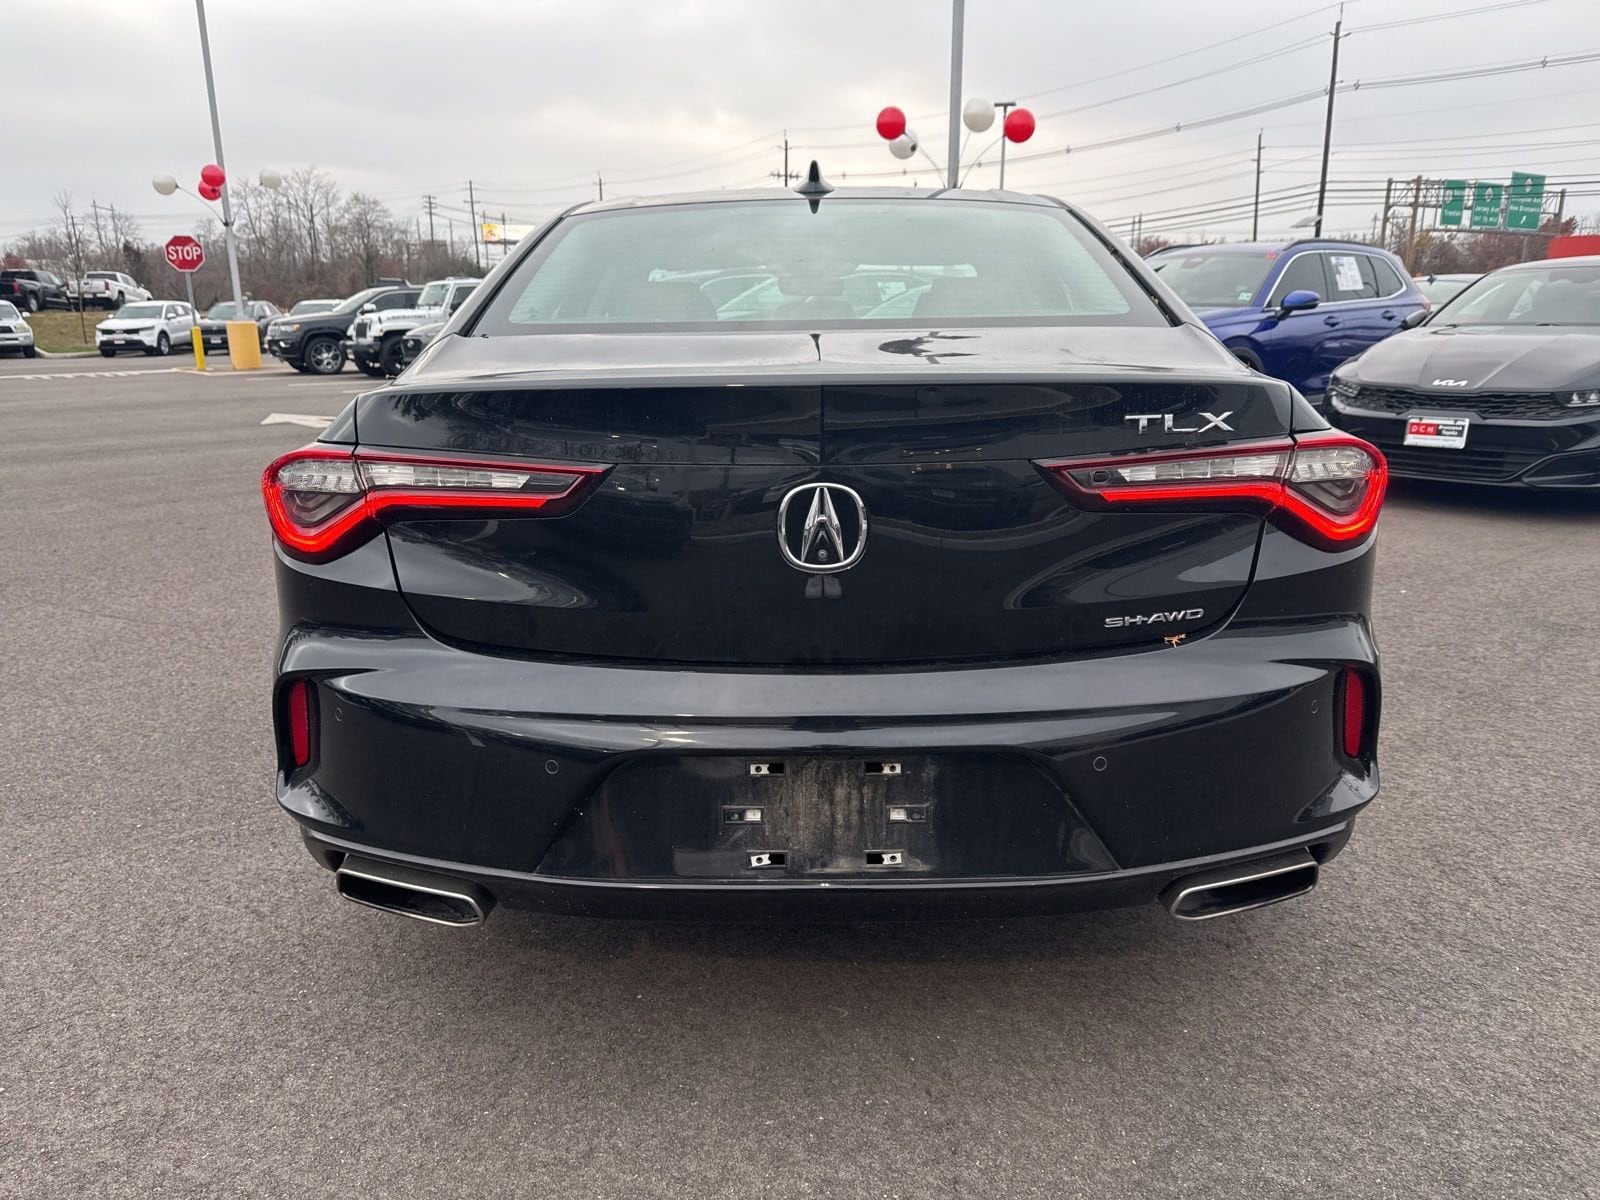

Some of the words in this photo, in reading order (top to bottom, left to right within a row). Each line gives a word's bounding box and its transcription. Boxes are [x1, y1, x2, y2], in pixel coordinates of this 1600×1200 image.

[168, 246, 201, 260] STOP
[1125, 411, 1234, 434] TLX
[1104, 608, 1204, 628] SH-AWD
